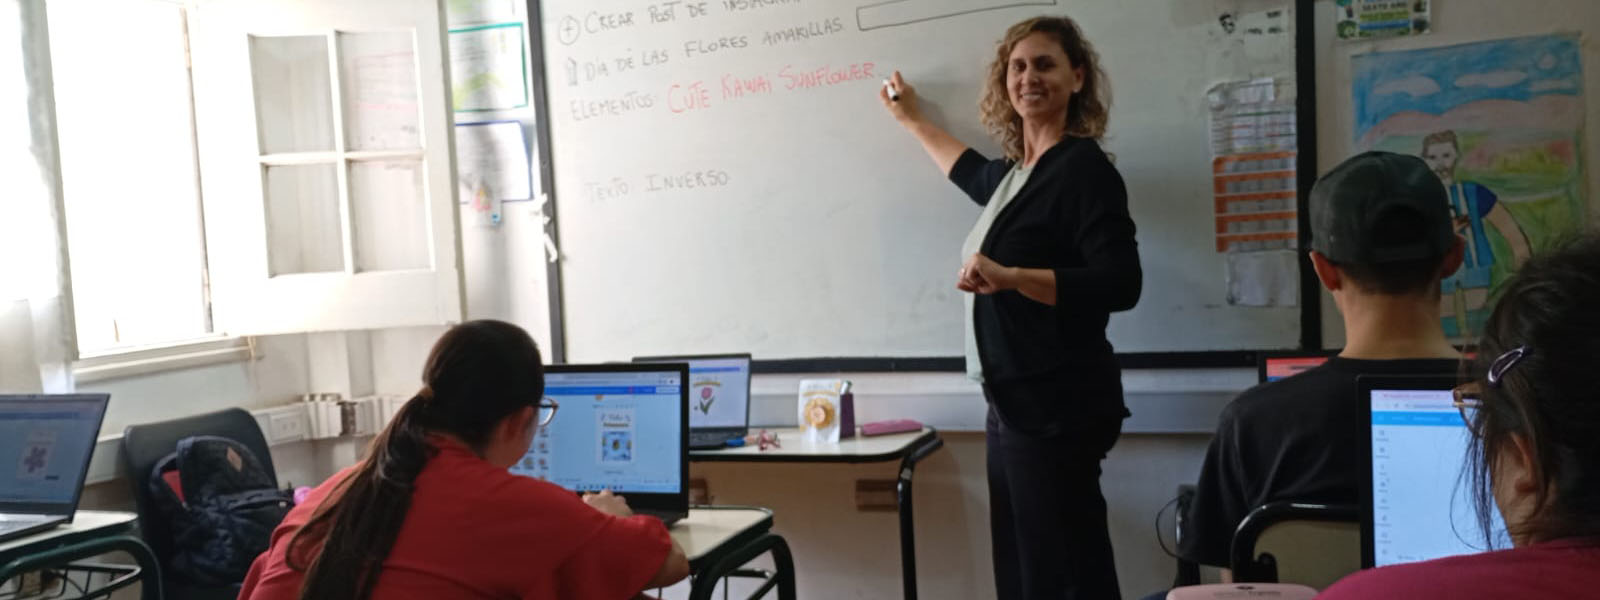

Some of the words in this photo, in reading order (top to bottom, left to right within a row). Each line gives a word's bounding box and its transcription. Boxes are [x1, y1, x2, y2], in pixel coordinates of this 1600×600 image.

[585, 11, 635, 34] CREAR
[687, 2, 708, 18] DE
[641, 51, 669, 66] LAS
[684, 37, 748, 57] FLORES
[762, 17, 843, 46] AMARILLAS
[667, 81, 712, 113] CUTE
[778, 62, 875, 90] SUNFLOWER
[645, 170, 730, 192] INVERSO
